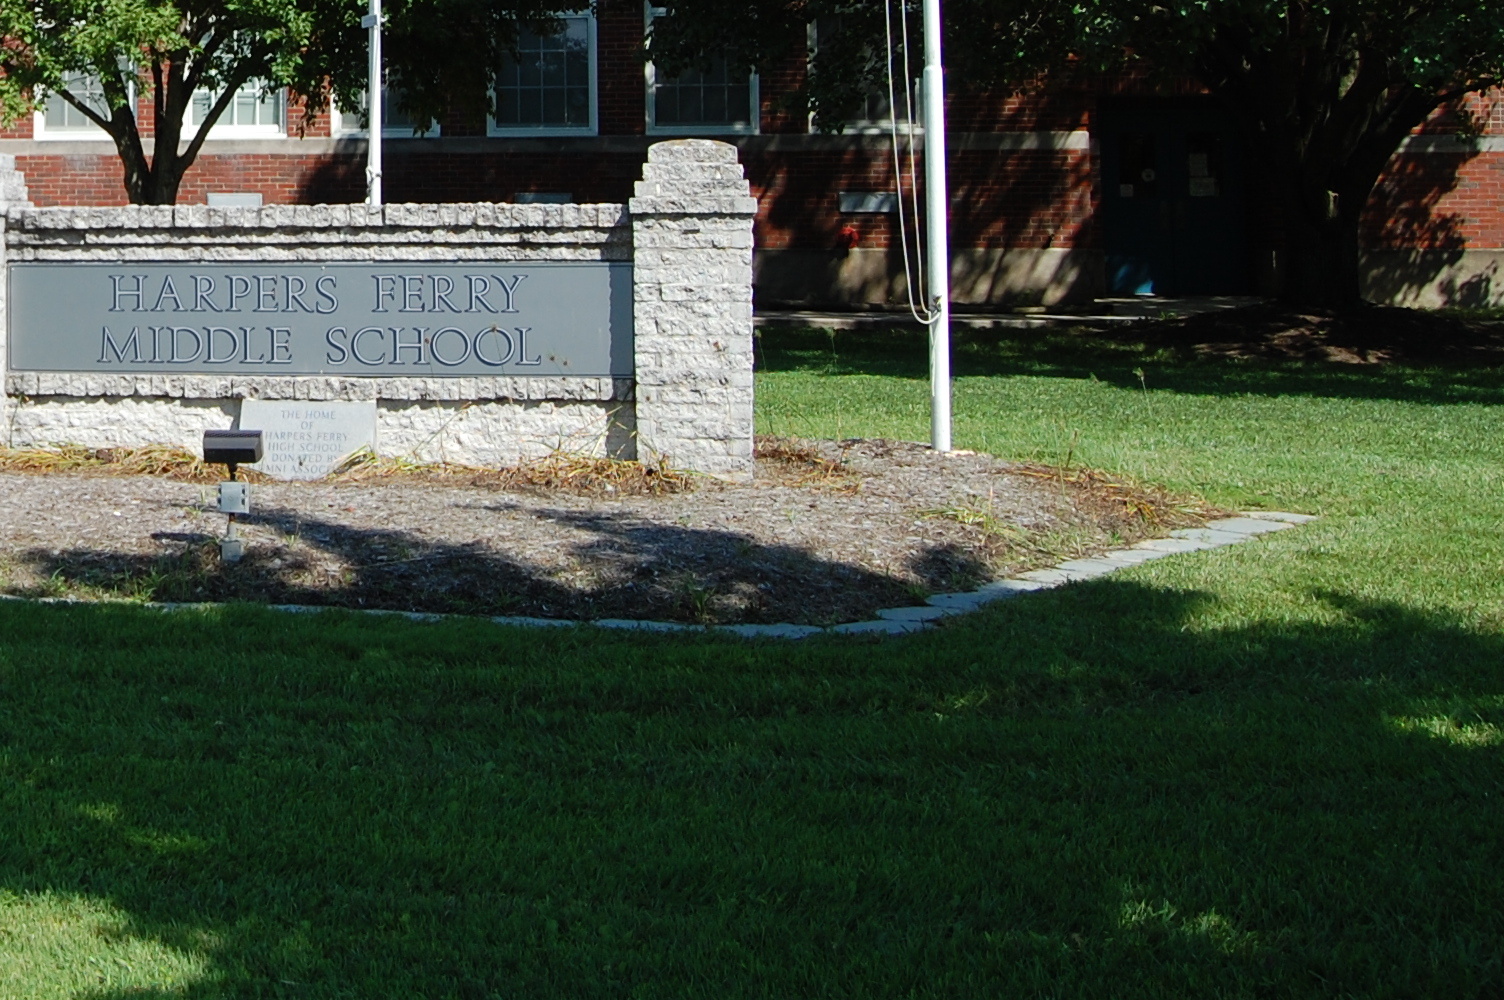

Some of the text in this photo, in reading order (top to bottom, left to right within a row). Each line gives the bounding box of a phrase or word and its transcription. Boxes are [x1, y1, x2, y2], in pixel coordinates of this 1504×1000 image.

[108, 274, 529, 314] HARPERS FERRY
[97, 325, 543, 367] MIDDLE SCHOOL
[281, 410, 337, 420] THE HOME
[300, 421, 314, 430] OF
[265, 431, 349, 442] HARPERS FERRY
[268, 442, 344, 453] HIGH SCHOOL
[271, 453, 323, 463] DONATED
